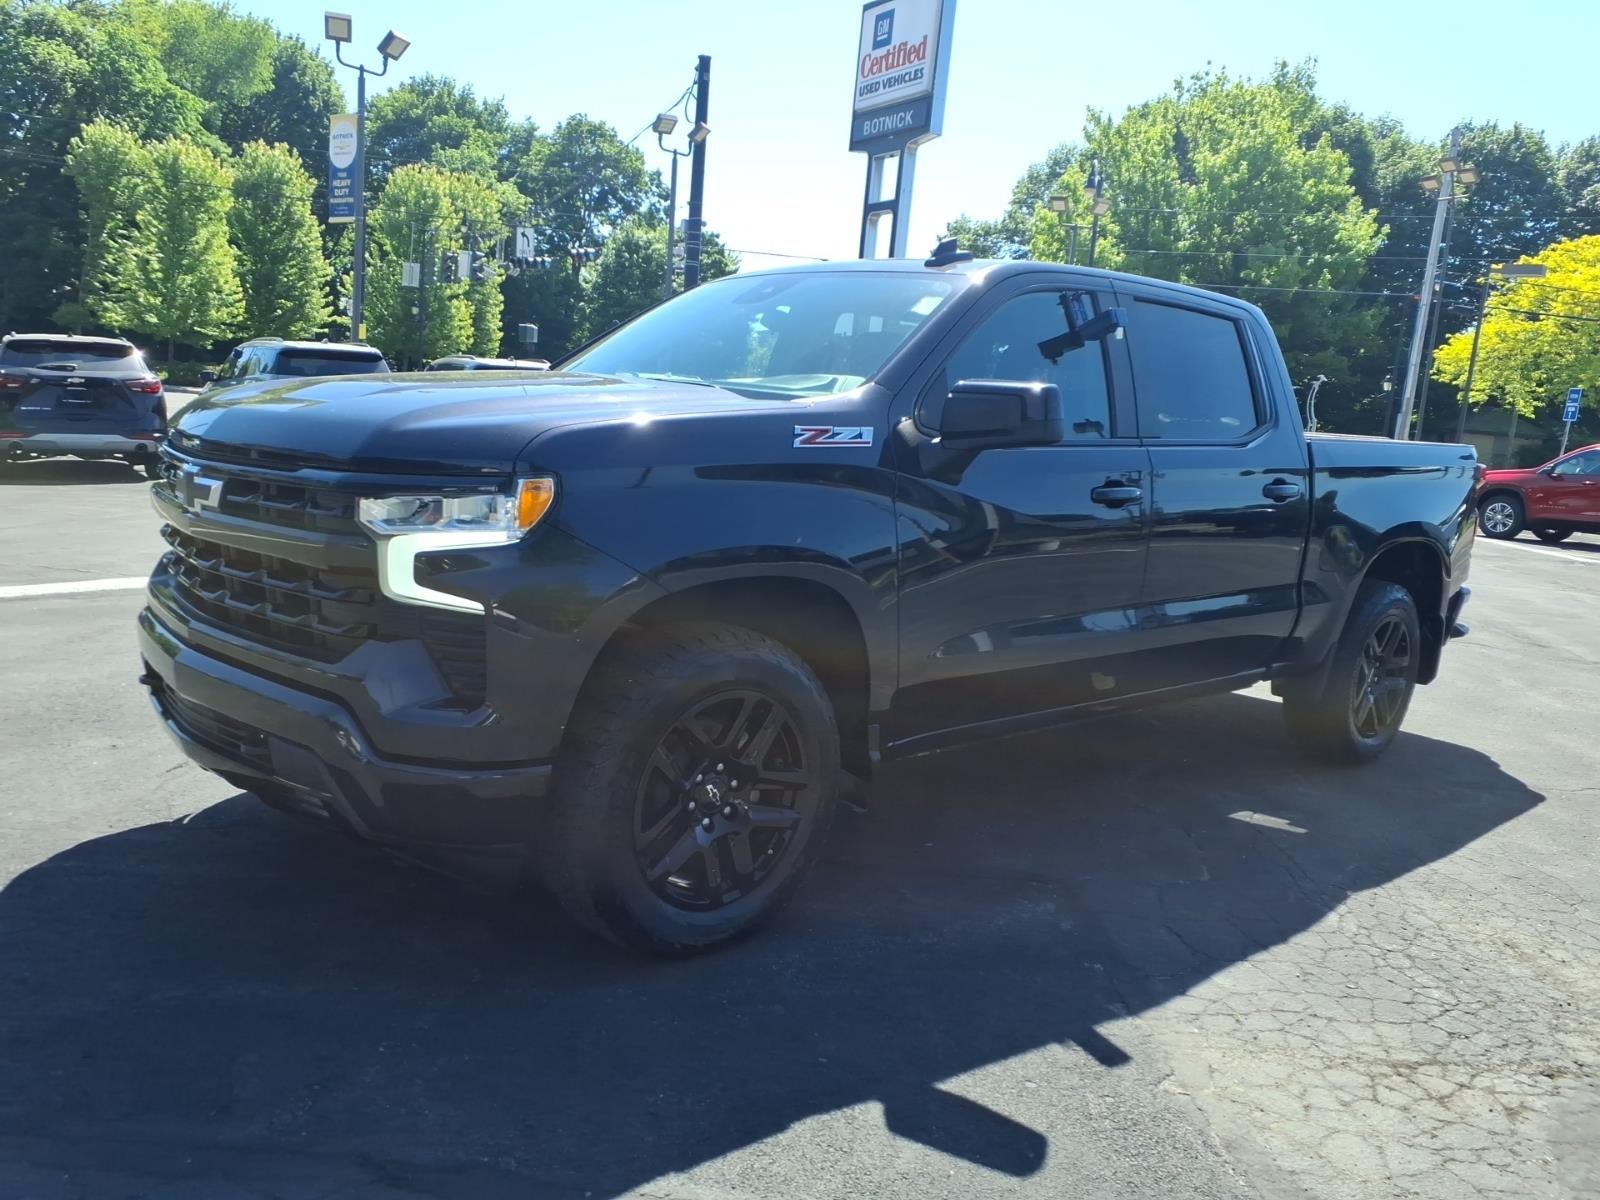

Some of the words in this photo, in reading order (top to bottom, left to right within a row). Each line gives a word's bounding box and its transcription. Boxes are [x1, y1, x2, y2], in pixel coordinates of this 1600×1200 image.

[877, 17, 890, 35] GM
[861, 34, 928, 78] Certified
[859, 81, 880, 97] USED
[882, 67, 925, 90] VEHICLES
[863, 110, 914, 136] BOTNICK
[332, 179, 351, 187] HEAVY
[334, 188, 349, 196] DUTY
[793, 425, 874, 448] Z71
